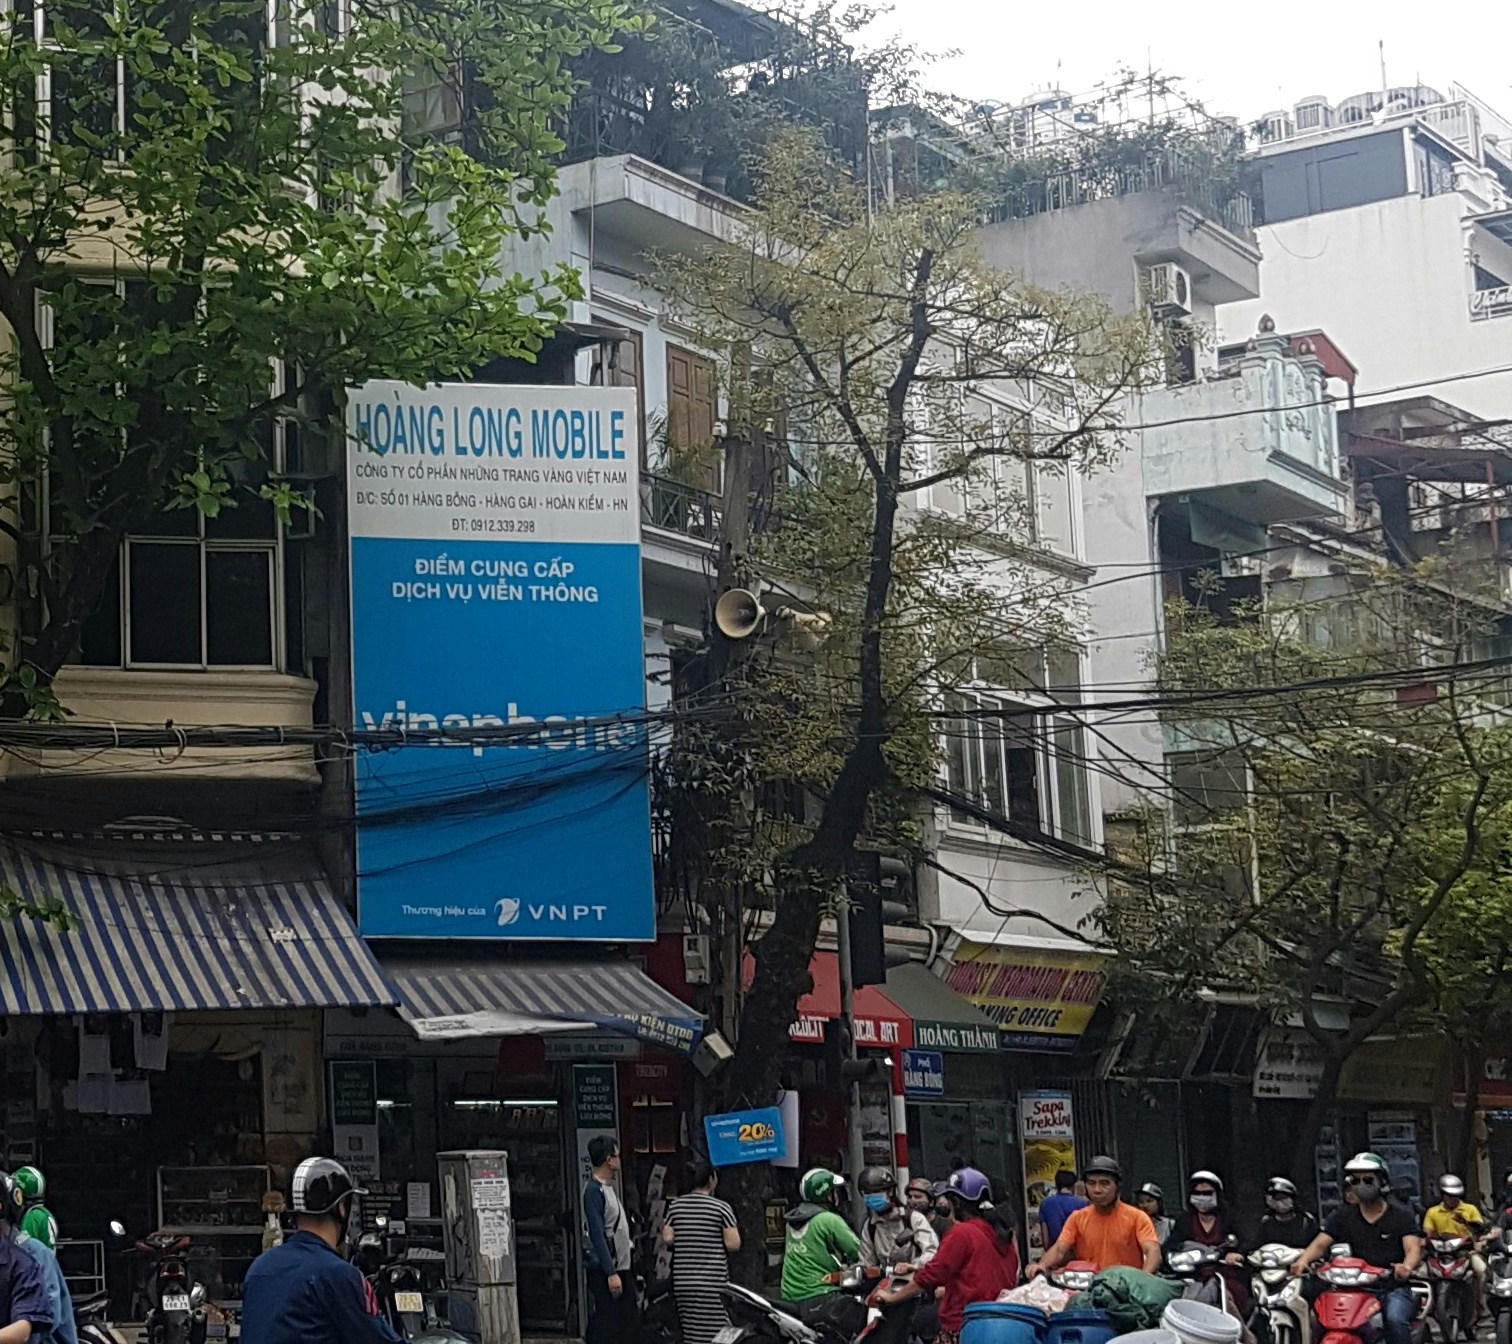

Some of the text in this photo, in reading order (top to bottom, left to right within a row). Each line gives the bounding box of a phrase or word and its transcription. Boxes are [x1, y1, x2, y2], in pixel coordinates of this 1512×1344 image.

[355, 391, 627, 459] HOÀNG LONG MOBILE
[355, 463, 388, 479] CÔNG
[391, 467, 405, 480] TY
[503, 469, 540, 483] TRANG
[543, 466, 573, 484] VÀNG
[577, 468, 601, 486] VIỆT
[603, 471, 628, 484] NAM
[397, 493, 409, 506] 01
[412, 490, 443, 507] HÀNG
[485, 491, 516, 508] HÀNG
[519, 496, 537, 509] GAI
[545, 494, 576, 511] HOÀN
[613, 499, 628, 512] HN
[470, 519, 535, 534] 0912.339.298
[414, 553, 575, 578] ĐIỂM CUNG CẤP
[391, 578, 599, 604] DỊCH VỤ VIỄN THÔNG
[527, 904, 607, 921] VNPT
[1017, 1006, 1063, 1028] OFFICE
[880, 1021, 899, 1044] ART
[919, 1023, 958, 1047] HOÀNG
[960, 1025, 998, 1049] THÀNH
[1033, 1101, 1064, 1122] Sapa
[738, 1122, 775, 1143] 20%
